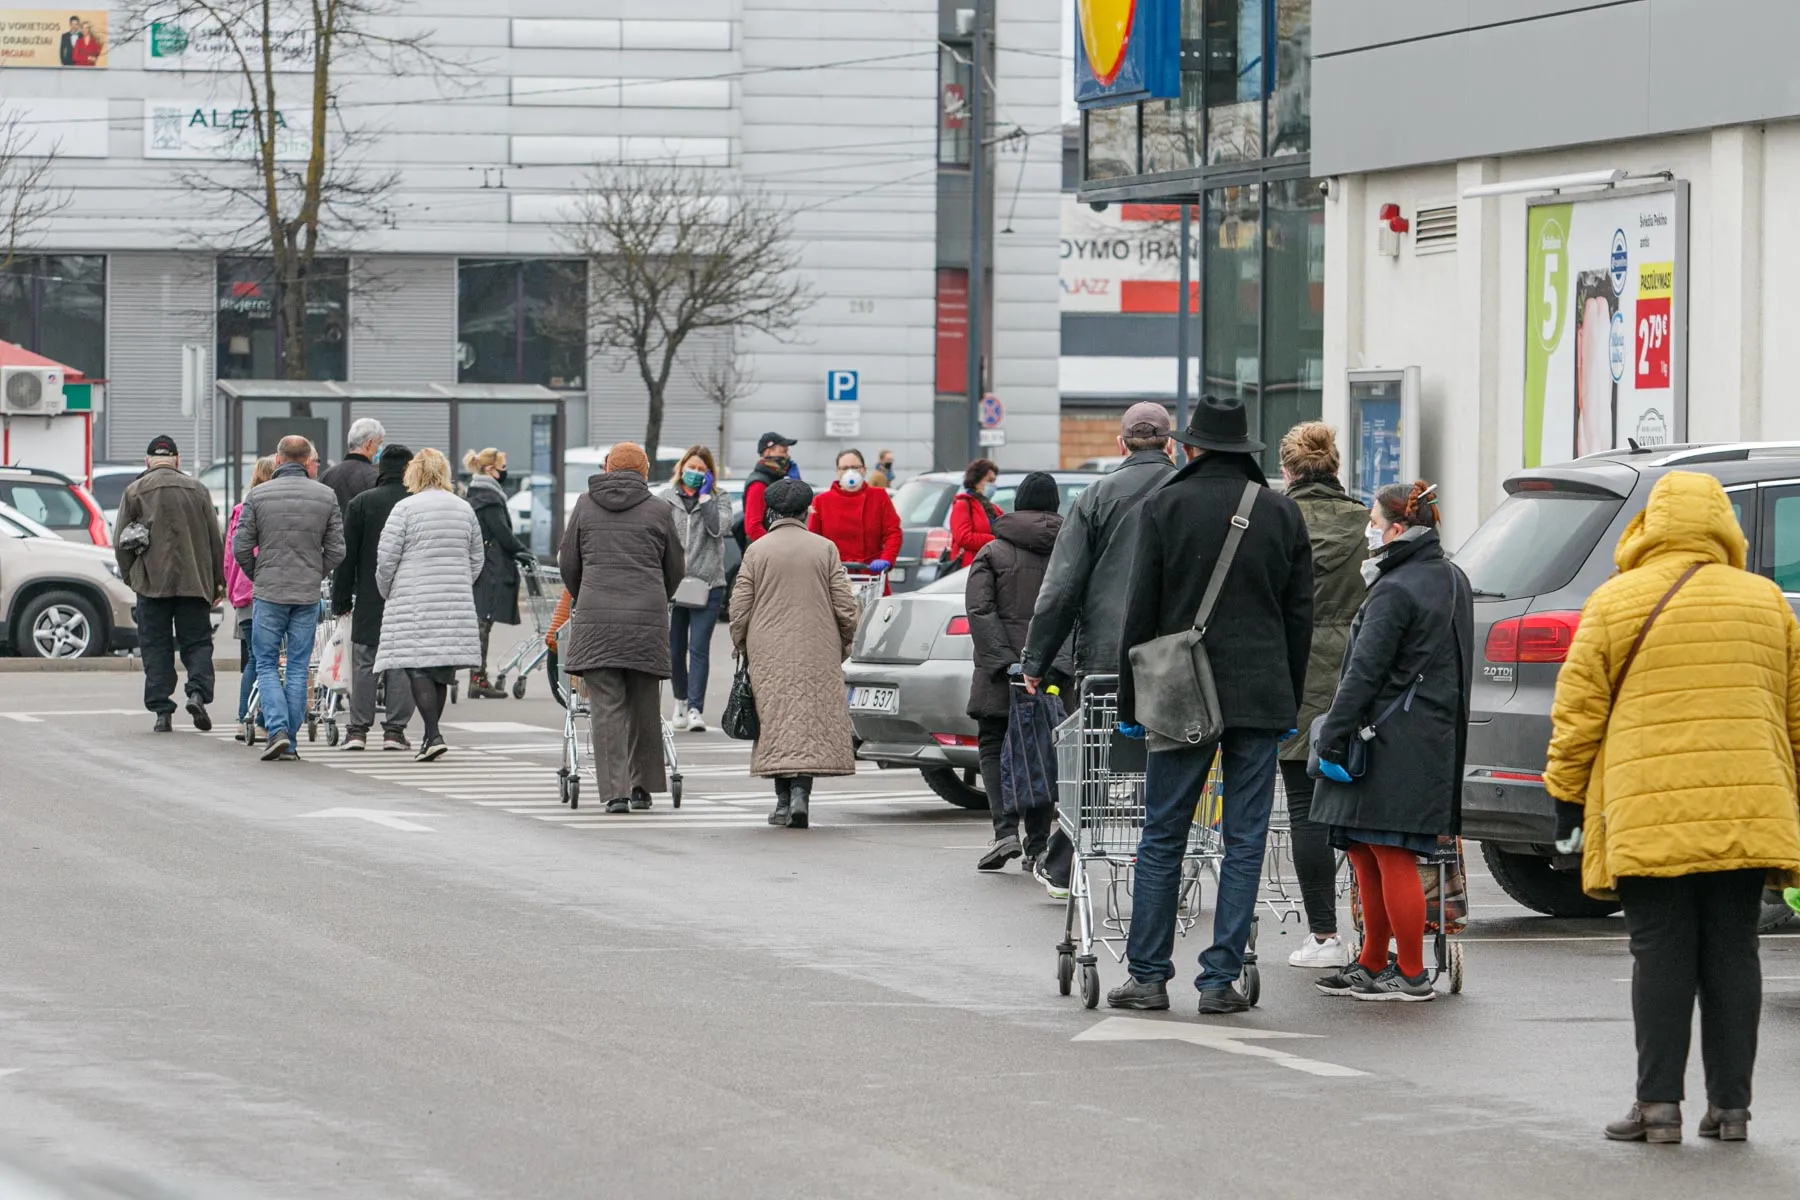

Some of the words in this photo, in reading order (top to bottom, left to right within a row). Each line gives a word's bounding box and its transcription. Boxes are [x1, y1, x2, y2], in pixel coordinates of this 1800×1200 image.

[8, 22, 60, 31] VOKIETIJOS
[1542, 254, 1559, 341] 5
[833, 372, 856, 400] P
[1497, 667, 1513, 677] TDI
[873, 690, 893, 708] 537
[1386, 980, 1400, 990] N
